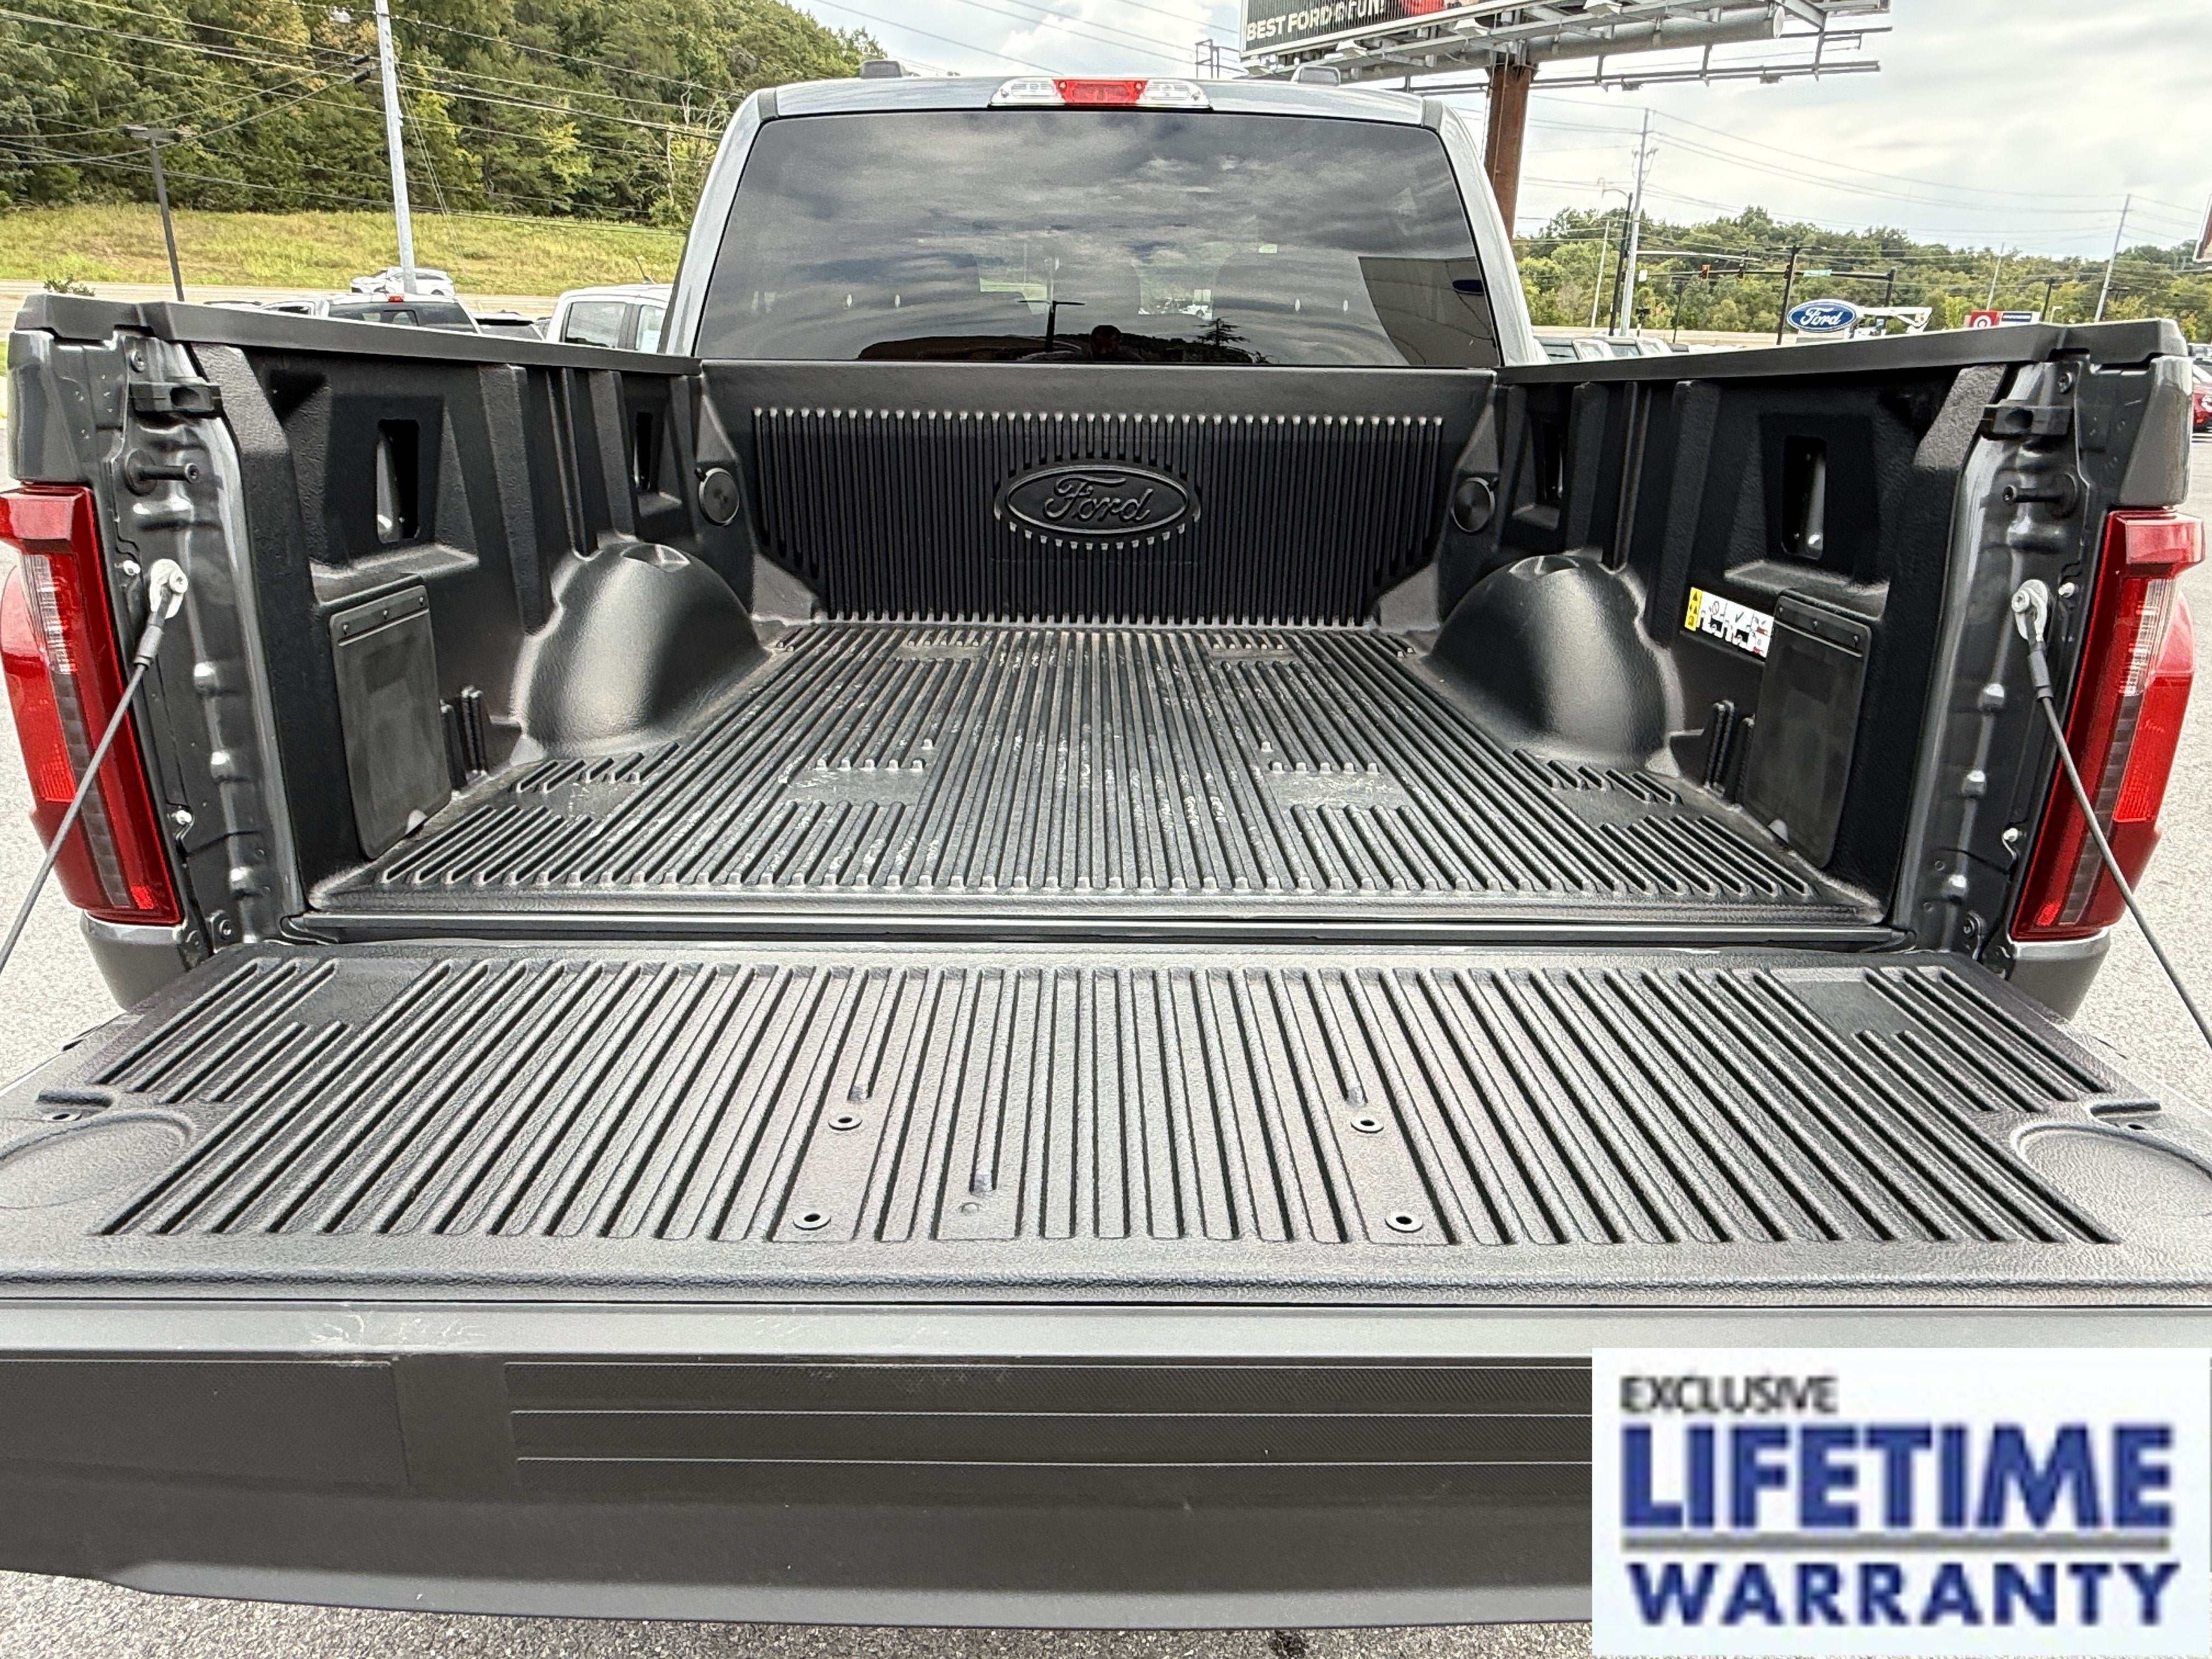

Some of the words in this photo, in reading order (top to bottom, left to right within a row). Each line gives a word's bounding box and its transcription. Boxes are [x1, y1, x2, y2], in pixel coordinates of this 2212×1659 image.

[1247, 15, 1286, 41] BEST
[1800, 307, 1843, 325] Ford
[1043, 475, 1153, 522] Ford
